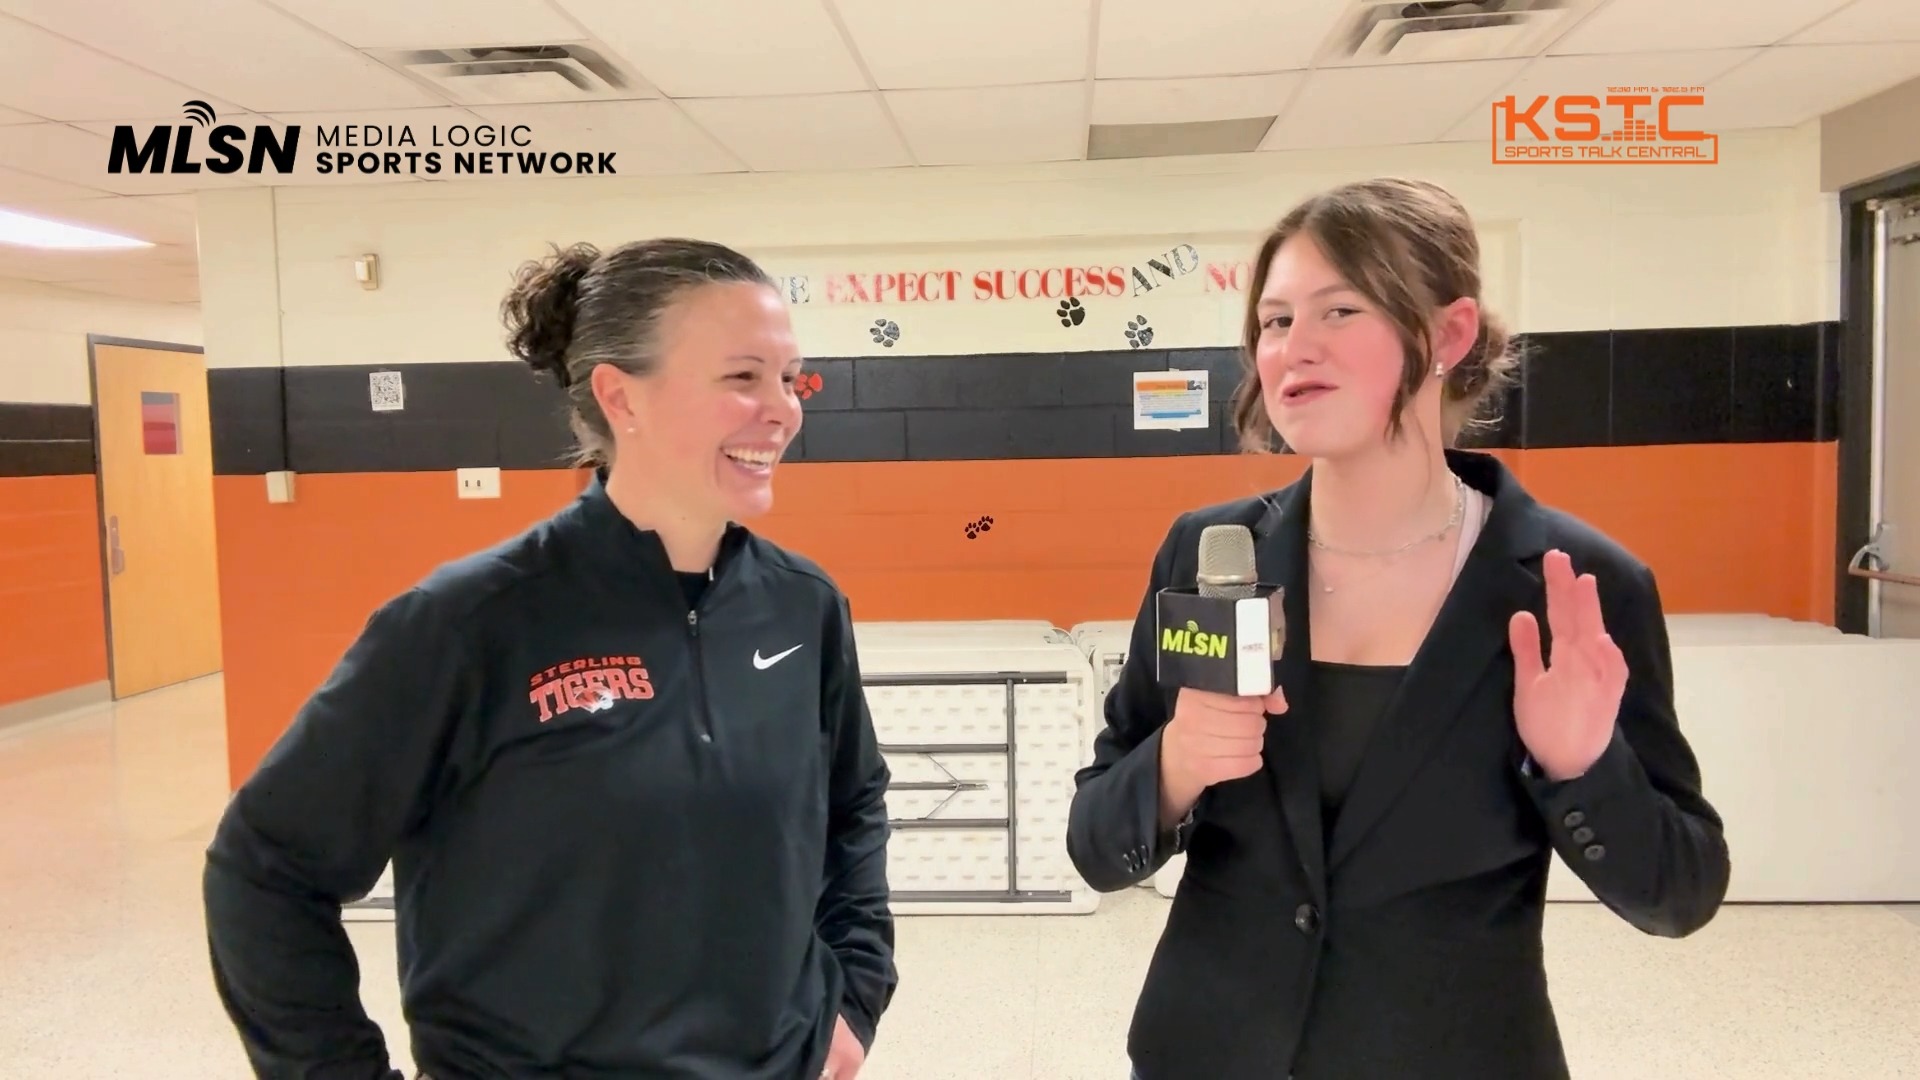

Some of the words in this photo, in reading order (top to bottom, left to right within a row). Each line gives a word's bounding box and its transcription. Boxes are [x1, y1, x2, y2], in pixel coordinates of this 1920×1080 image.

[780, 275, 810, 305] E
[826, 270, 962, 304] EXPECT
[973, 265, 1126, 301] SUCCESS
[1129, 243, 1199, 298] AND
[1162, 628, 1228, 659] MLSN
[529, 655, 642, 687] STERLING
[529, 667, 655, 723] TIGERS
